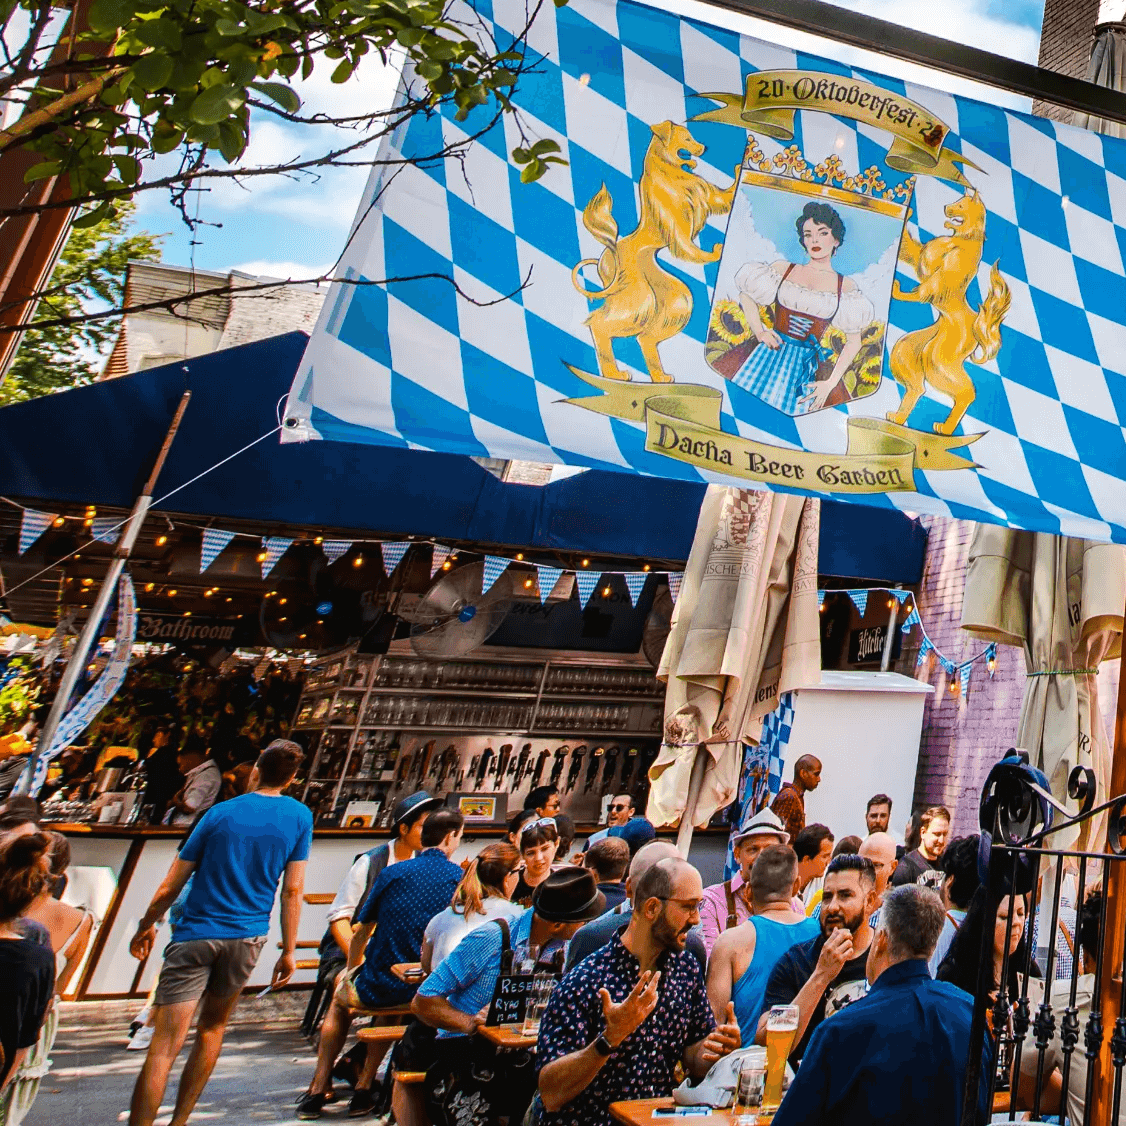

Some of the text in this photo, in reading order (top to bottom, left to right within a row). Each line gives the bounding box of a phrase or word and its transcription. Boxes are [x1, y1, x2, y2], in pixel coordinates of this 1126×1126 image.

[653, 422, 905, 487] Dacha Beer Garden
[138, 617, 235, 641] Bathroom
